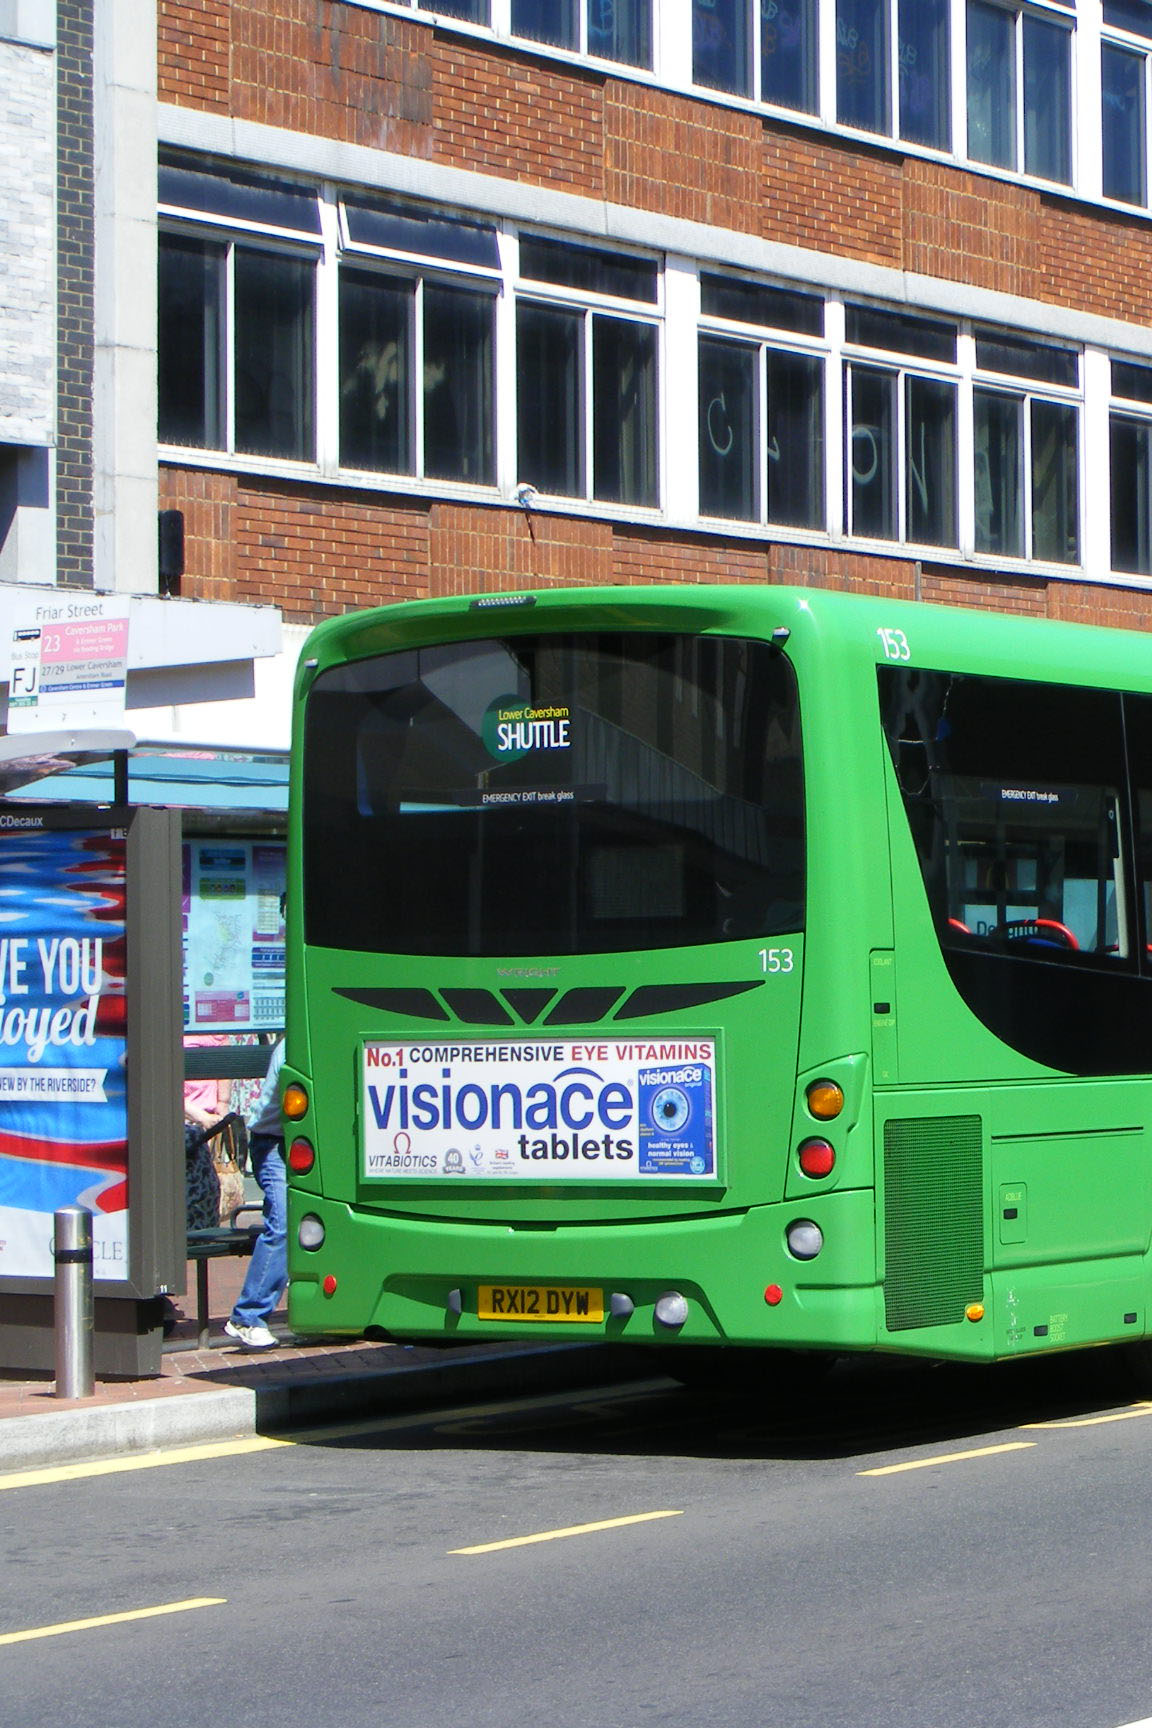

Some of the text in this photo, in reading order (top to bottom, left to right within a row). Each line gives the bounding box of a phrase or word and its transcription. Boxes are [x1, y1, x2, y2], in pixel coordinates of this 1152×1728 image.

[36, 604, 104, 620] Friar Street
[65, 622, 124, 636] Caversham Park
[44, 635, 61, 653] 23
[877, 628, 911, 661] 153
[42, 661, 122, 676] 27/29 Lower Caversham
[13, 667, 36, 693] FJ
[499, 706, 569, 721] Lower Caversham
[497, 719, 571, 751] SHUTTLE
[482, 790, 574, 803] EMERGENCY EXIT break glass
[38, 937, 103, 995] YOU
[757, 949, 793, 973] 153
[496, 967, 561, 978] WRIGHT
[367, 1044, 712, 1067] No.1 COMPREHENSIVE EYE VITAMINS
[17, 1077, 28, 1092] BY
[30, 1077, 45, 1092] THE
[48, 1078, 96, 1093] RIVERSIDE?
[639, 1066, 702, 1087] visionace
[368, 1066, 634, 1131] visionace
[518, 1133, 634, 1160] tablets
[648, 1142, 671, 1150] healthy
[369, 1155, 437, 1168] VITABIOTICS
[492, 1289, 589, 1316] RX12 DYW
